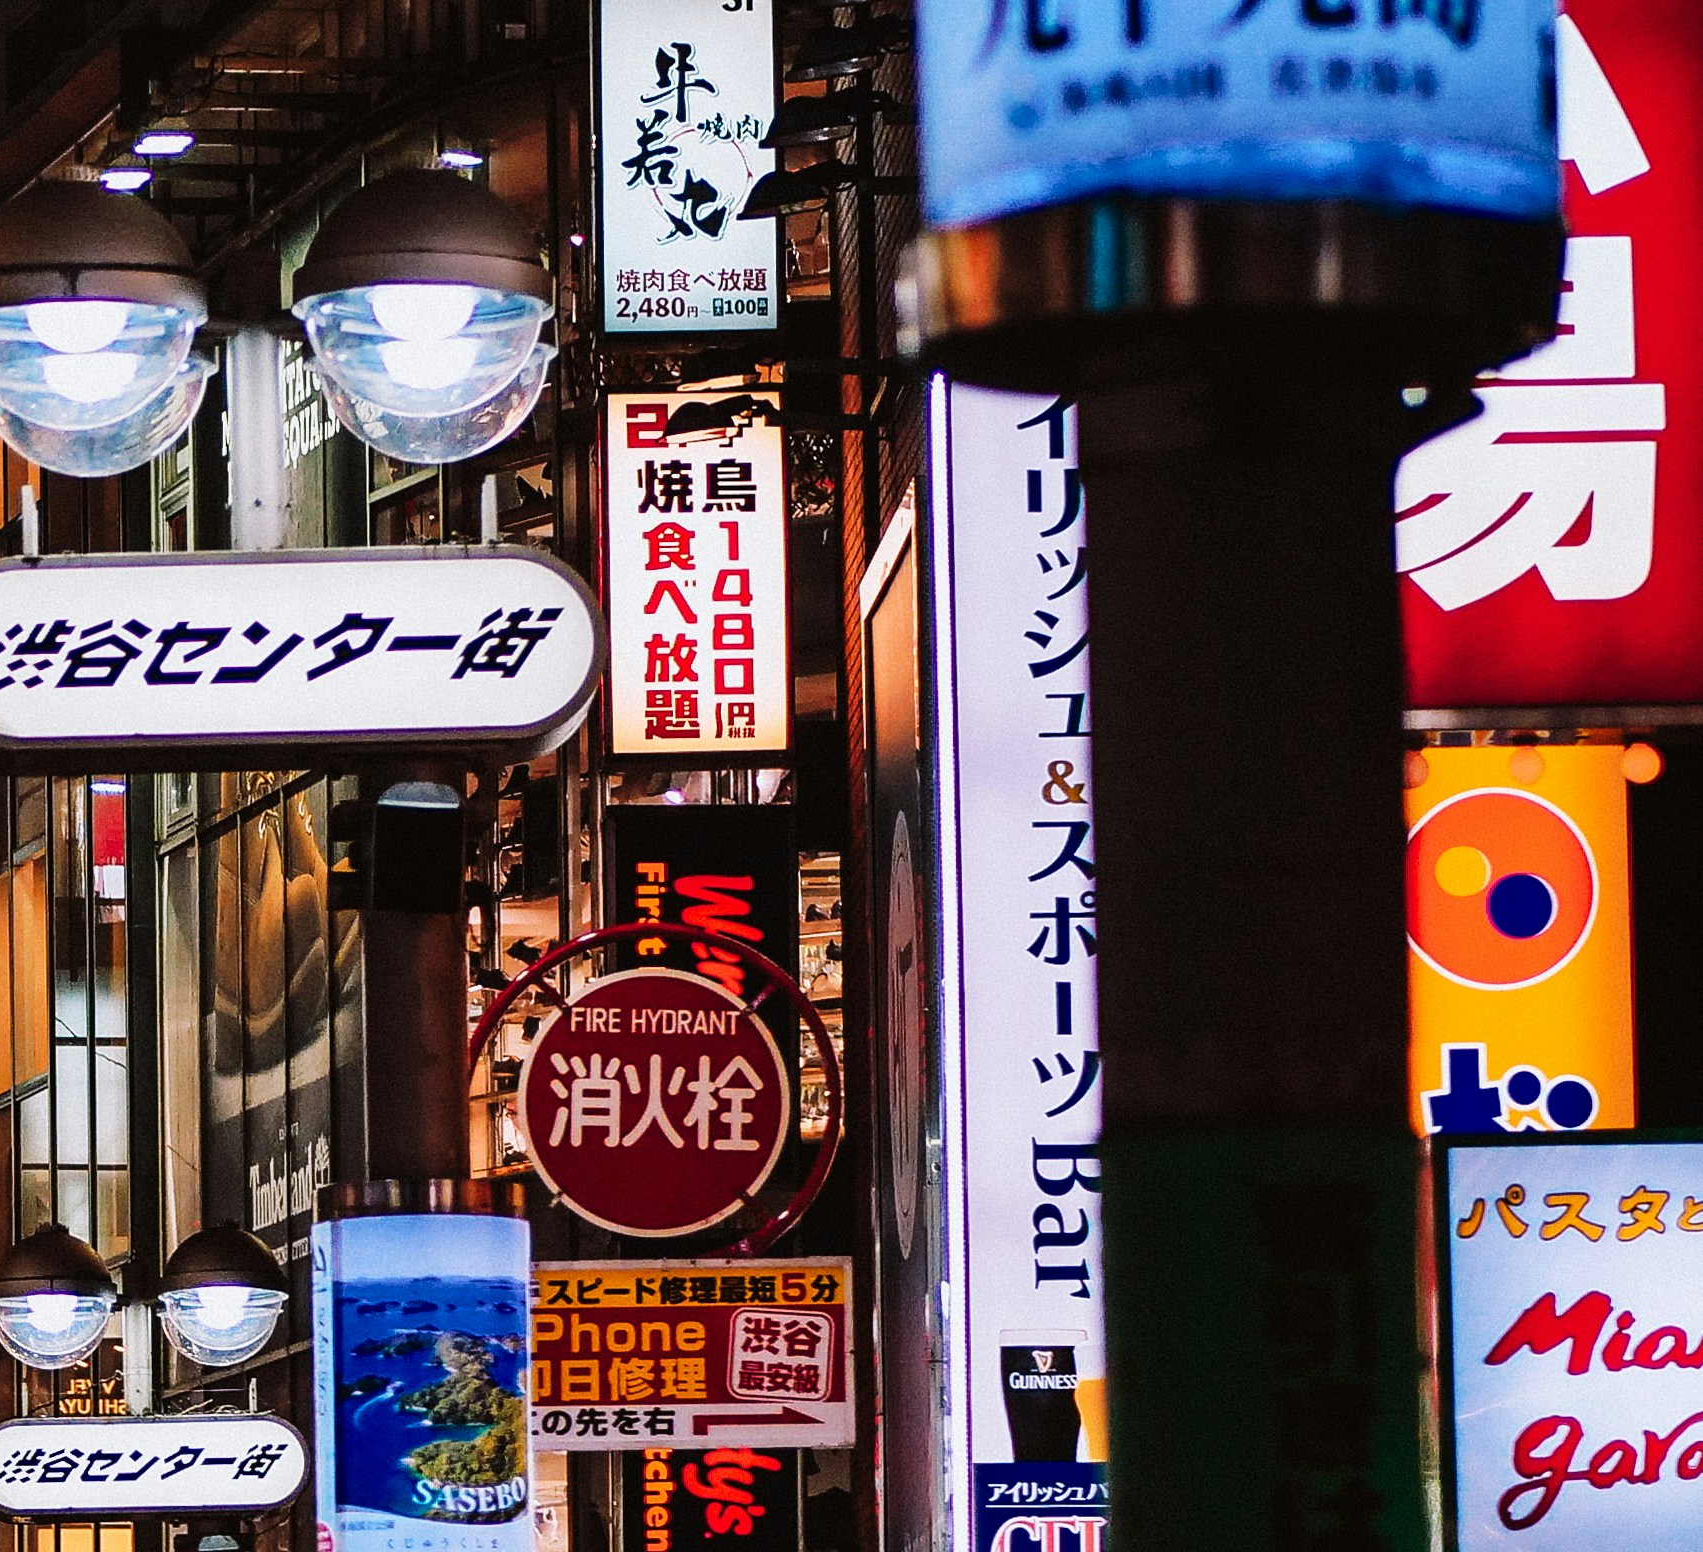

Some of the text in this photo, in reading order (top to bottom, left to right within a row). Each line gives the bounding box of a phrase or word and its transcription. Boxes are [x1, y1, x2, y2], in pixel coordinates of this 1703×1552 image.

[696, 113, 761, 142] 焼肉
[616, 268, 768, 292] 焼肉食べ放題
[570, 1007, 741, 1036] FIRE HYDRANT
[548, 1052, 764, 1151] 消火栓
[742, 1317, 823, 1358] 渋谷
[739, 1362, 821, 1395] 最安級
[1008, 1371, 1079, 1392] GUINNESS
[532, 1407, 676, 1437] の先を右
[411, 1475, 526, 1516] SASEBO
